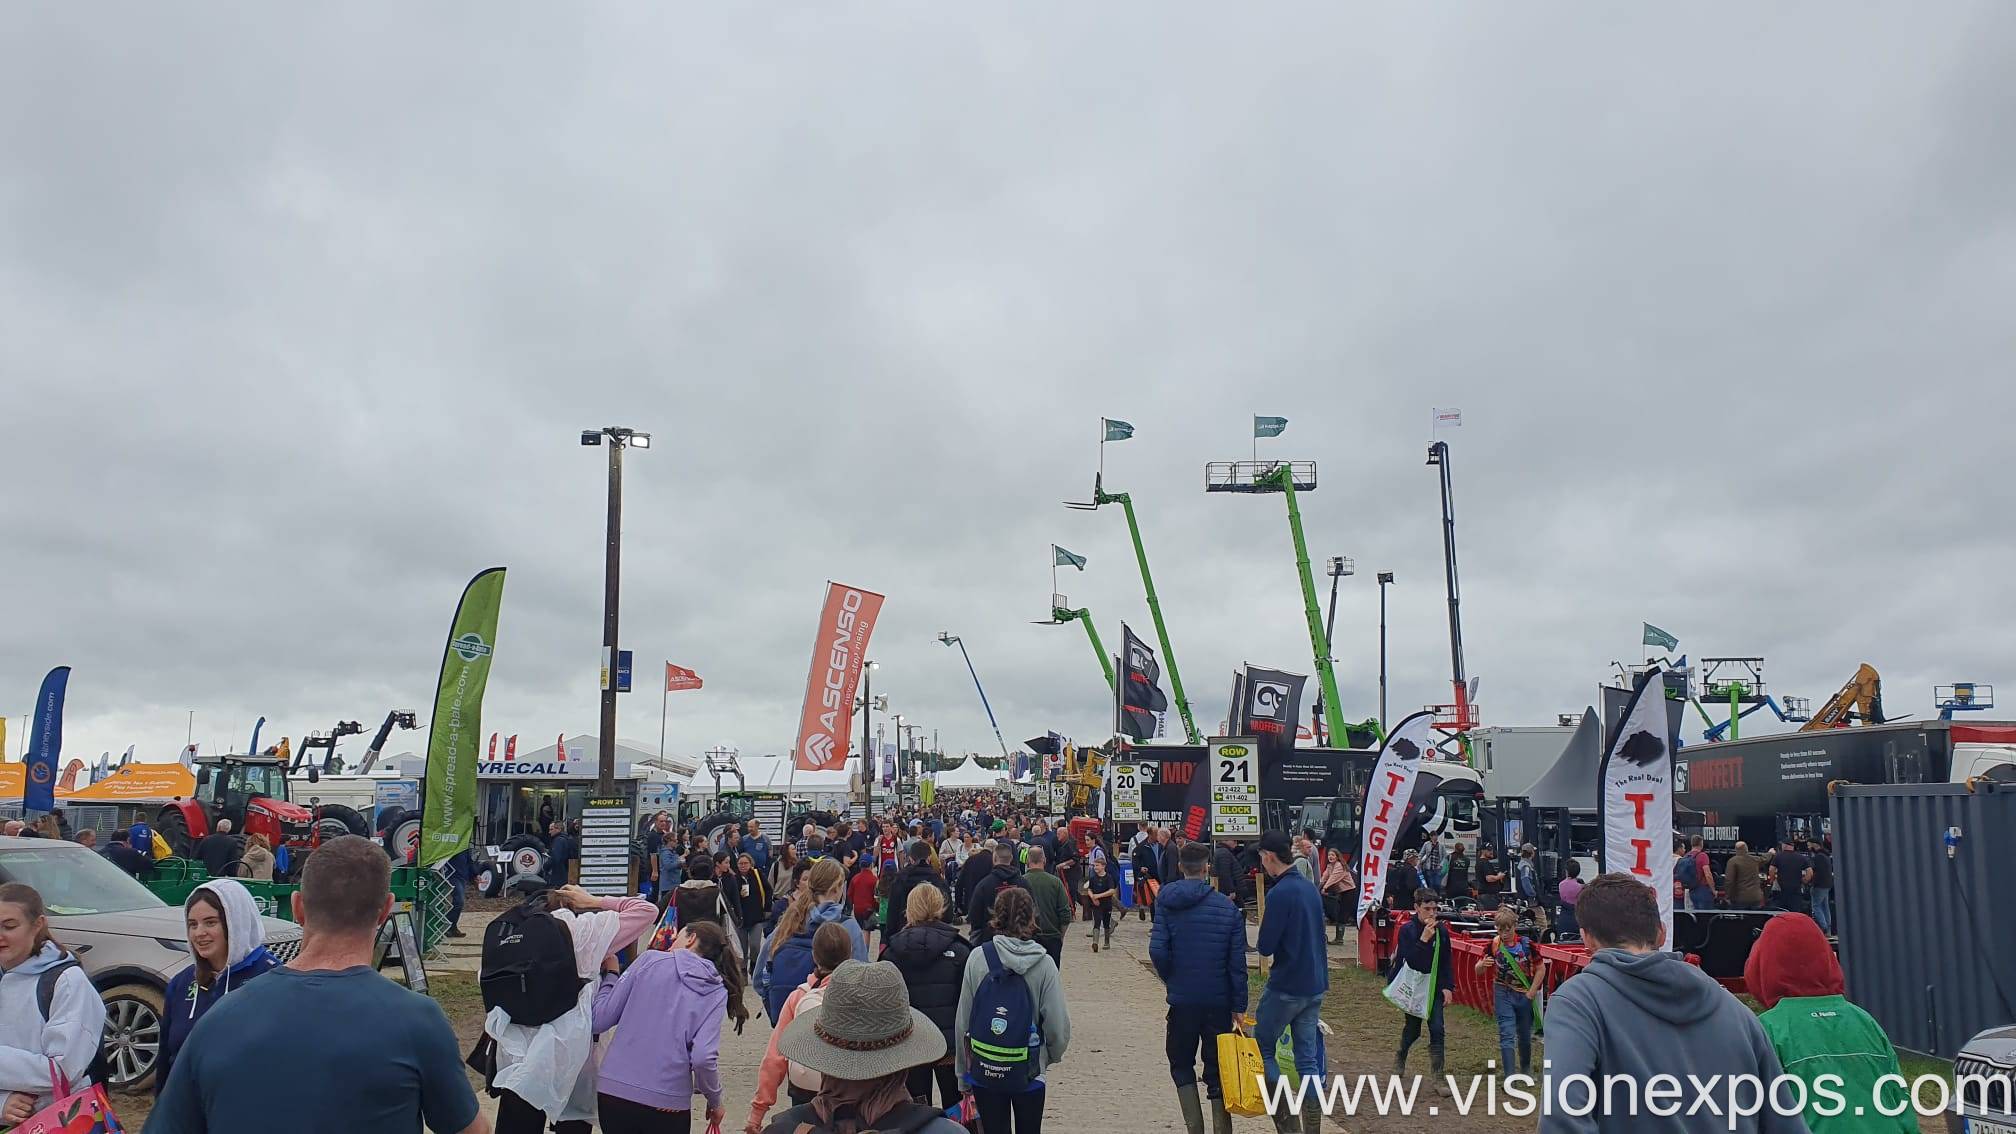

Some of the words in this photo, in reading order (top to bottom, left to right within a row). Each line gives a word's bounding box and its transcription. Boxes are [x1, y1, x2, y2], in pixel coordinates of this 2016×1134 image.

[856, 620, 869, 650] rising
[819, 590, 863, 735] ASCENSO
[852, 652, 861, 675] stop
[845, 679, 855, 705] never
[1250, 720, 1286, 733] MOFFETT
[443, 666, 470, 827] www.spread-a-bale.com
[477, 763, 568, 774] YRECALL
[1220, 760, 1249, 783] 21
[1688, 757, 1744, 790] MOFFETT
[1054, 788, 1064, 796] 19
[1117, 776, 1135, 788] 20
[1615, 778, 1628, 788] The
[1628, 774, 1644, 782] Real
[1647, 773, 1664, 784] Deal
[1151, 811, 1183, 821] WORLD'S
[1363, 771, 1405, 900] TIGHE
[1703, 826, 1715, 840] NTED
[1715, 826, 1739, 841] FORKLIFT
